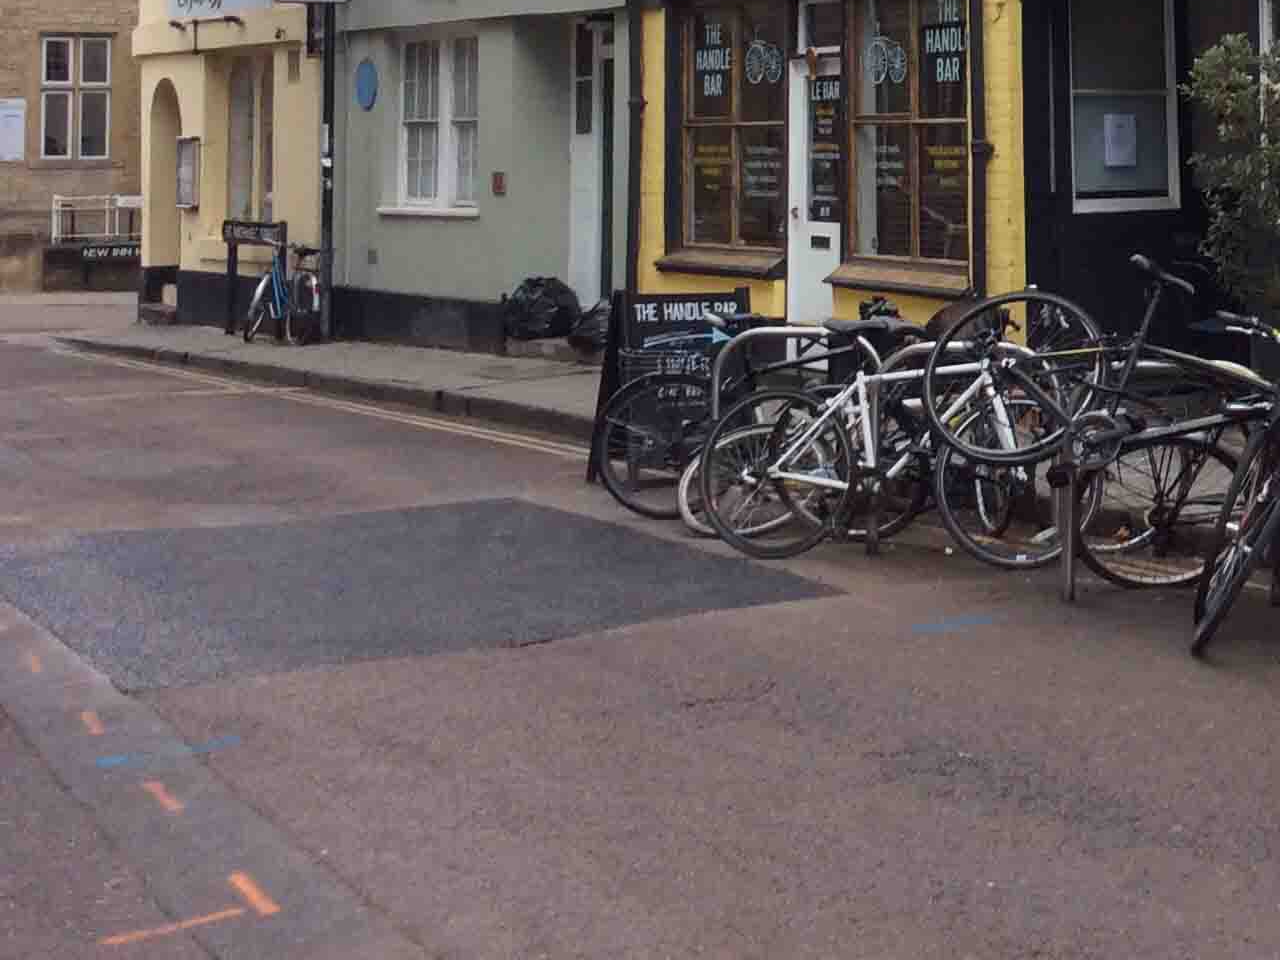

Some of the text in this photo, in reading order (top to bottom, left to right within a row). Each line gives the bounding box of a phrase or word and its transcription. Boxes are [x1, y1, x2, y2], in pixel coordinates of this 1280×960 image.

[705, 24, 722, 45] THE
[696, 46, 730, 72] HANDLE
[936, 57, 961, 82] BAR
[703, 74, 723, 97] BAR
[822, 79, 841, 100] BAR
[83, 247, 110, 257] NEW
[112, 247, 132, 257] INN
[633, 303, 658, 323] THE
[664, 301, 712, 322] HANDLE
